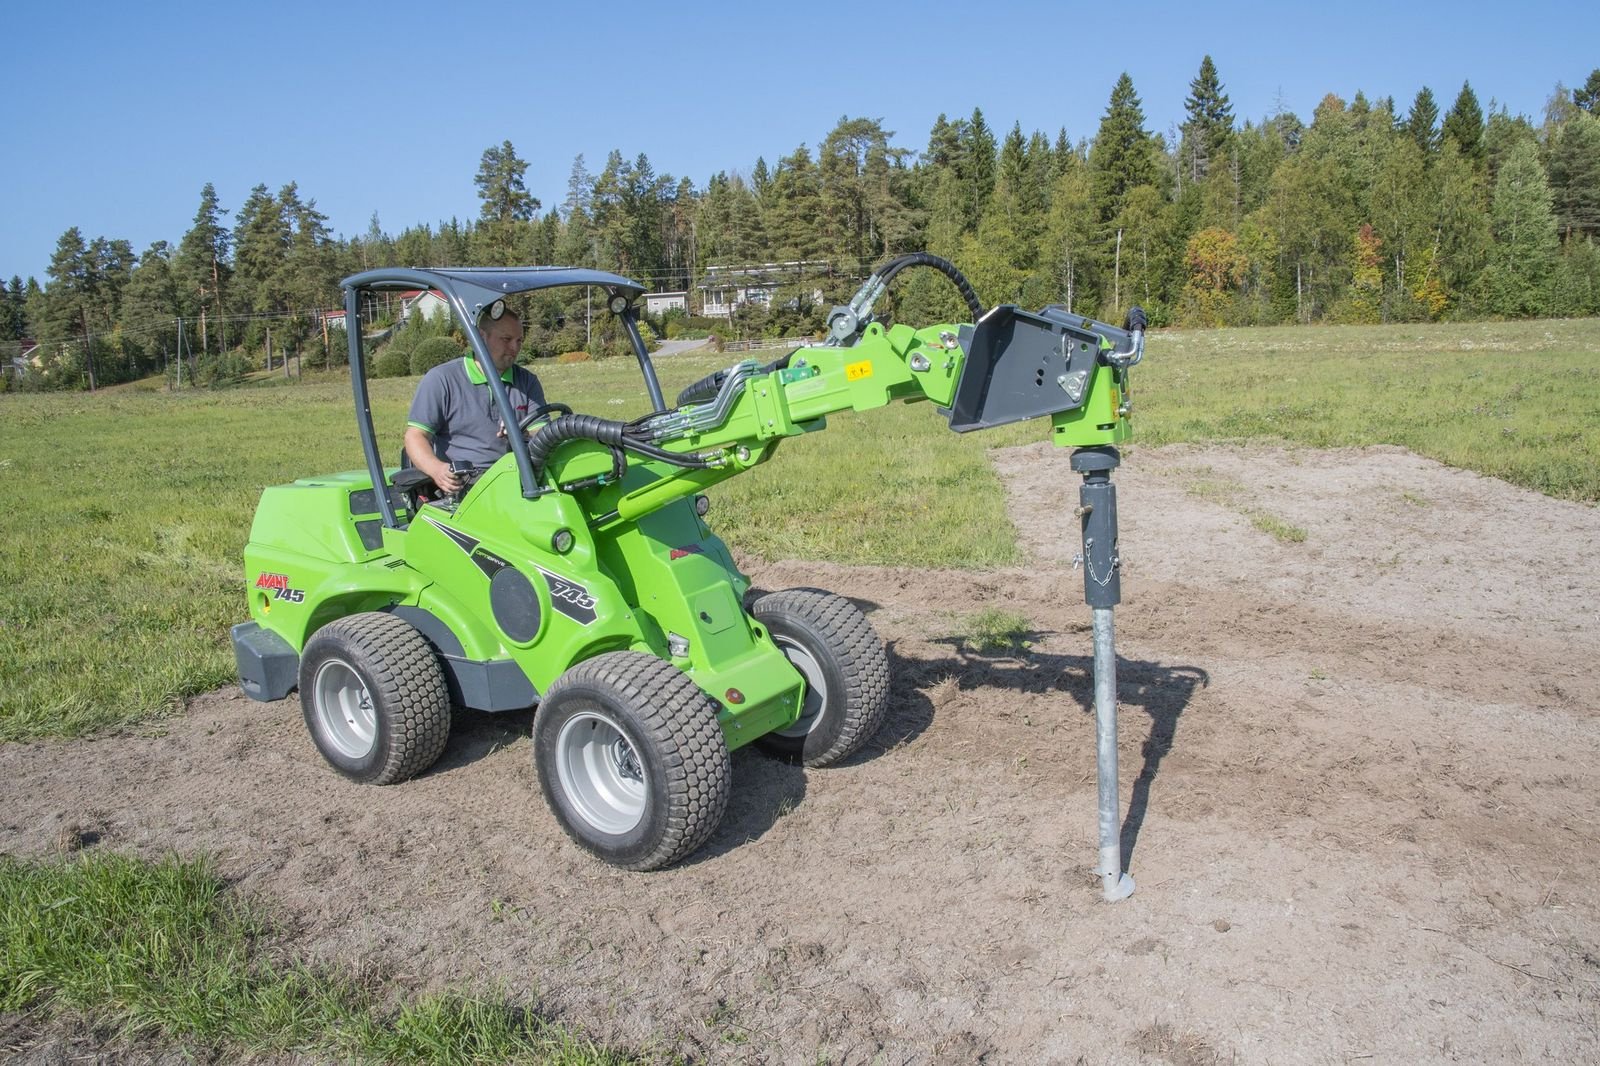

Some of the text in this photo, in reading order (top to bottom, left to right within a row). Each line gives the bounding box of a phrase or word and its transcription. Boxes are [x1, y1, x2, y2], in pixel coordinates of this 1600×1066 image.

[256, 573, 289, 590] AVANT
[273, 587, 305, 604] 745
[550, 581, 598, 609] 745
